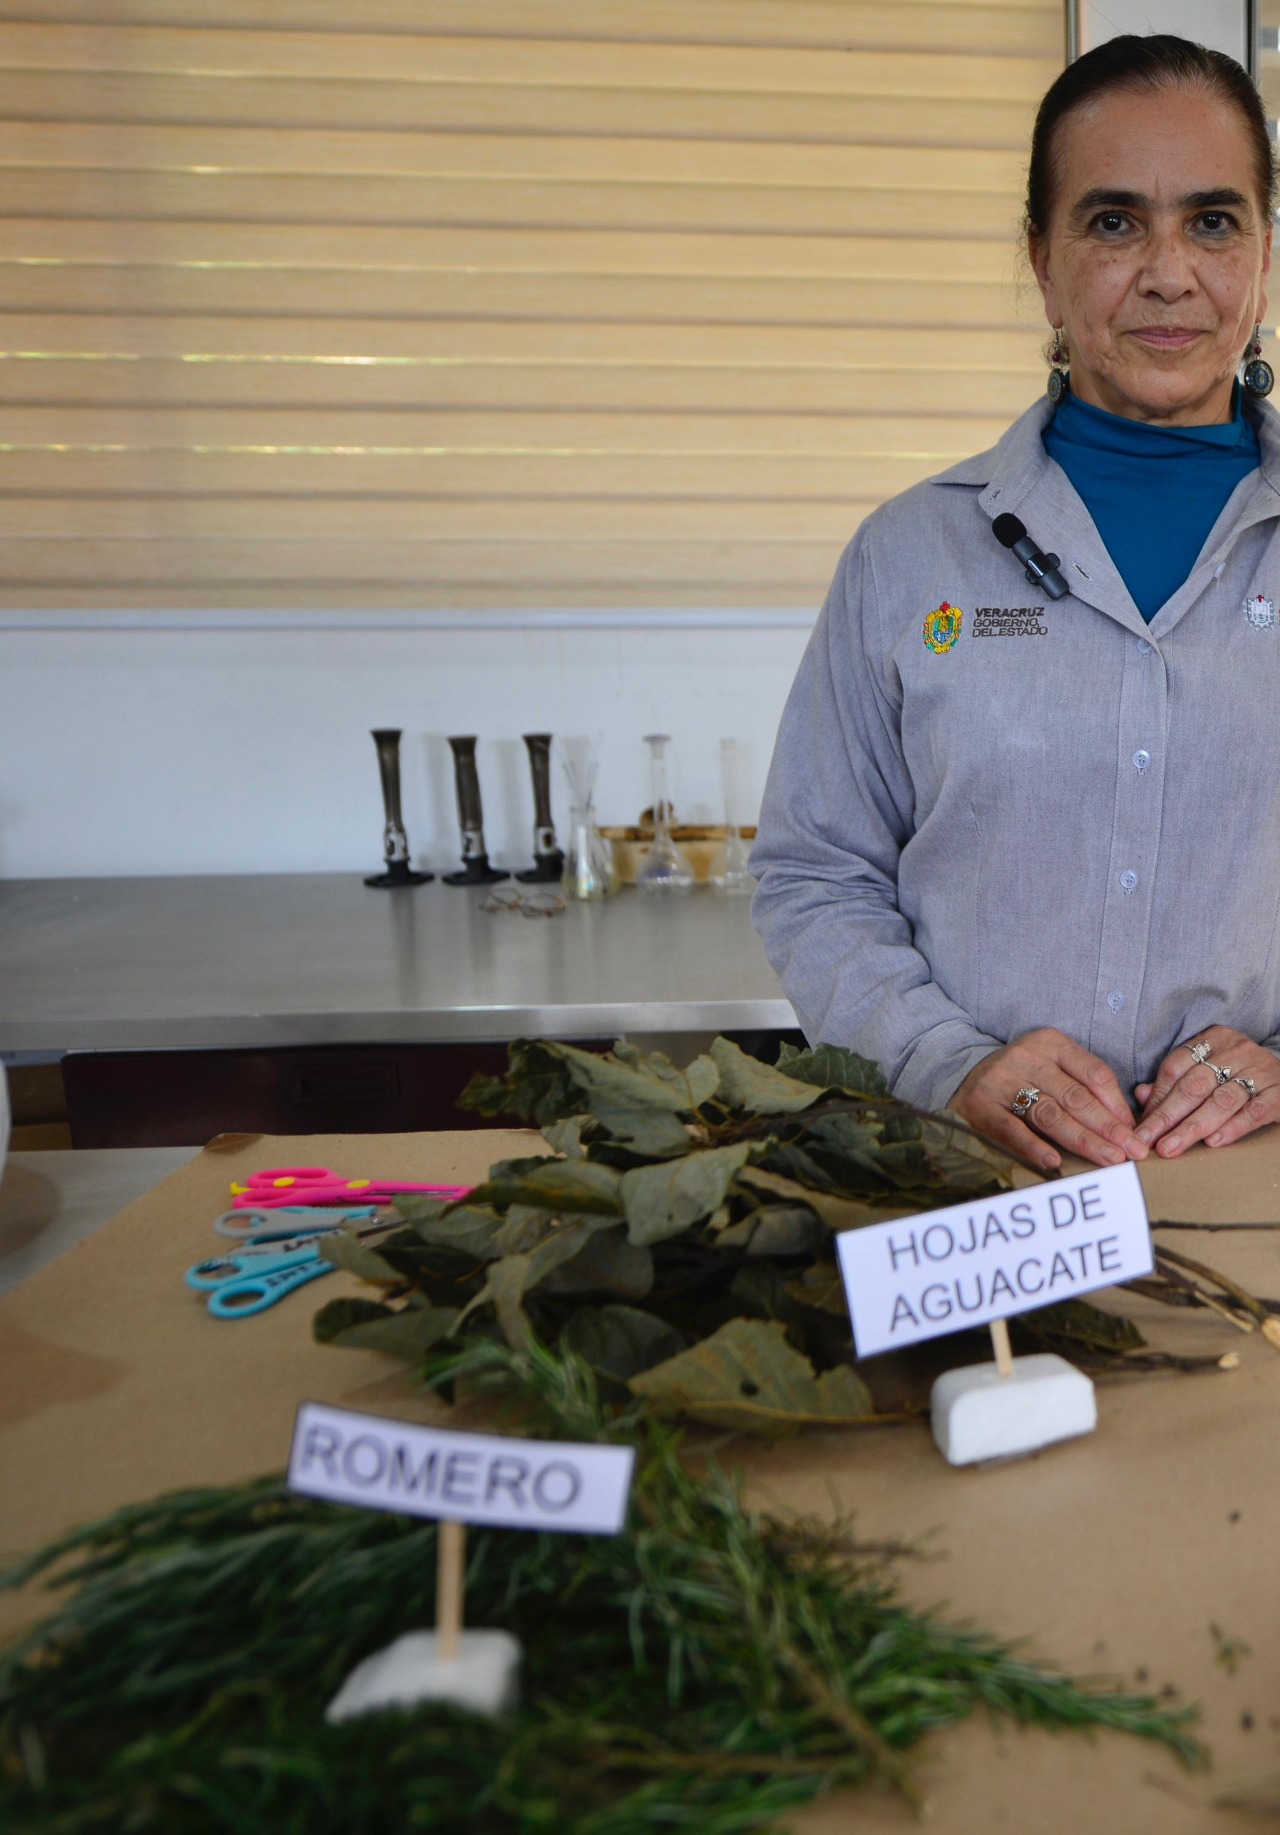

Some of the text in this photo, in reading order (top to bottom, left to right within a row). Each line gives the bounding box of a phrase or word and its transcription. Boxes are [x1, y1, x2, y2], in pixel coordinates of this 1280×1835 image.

[972, 626, 1048, 638] DEL ESTADO
[973, 617, 1039, 628] GOBIERNO
[975, 607, 1045, 618] VERACRUZ
[887, 1184, 1106, 1271] HOJAS DE
[889, 1235, 1123, 1333] AGUACATE
[301, 1422, 583, 1514] ROMERO
